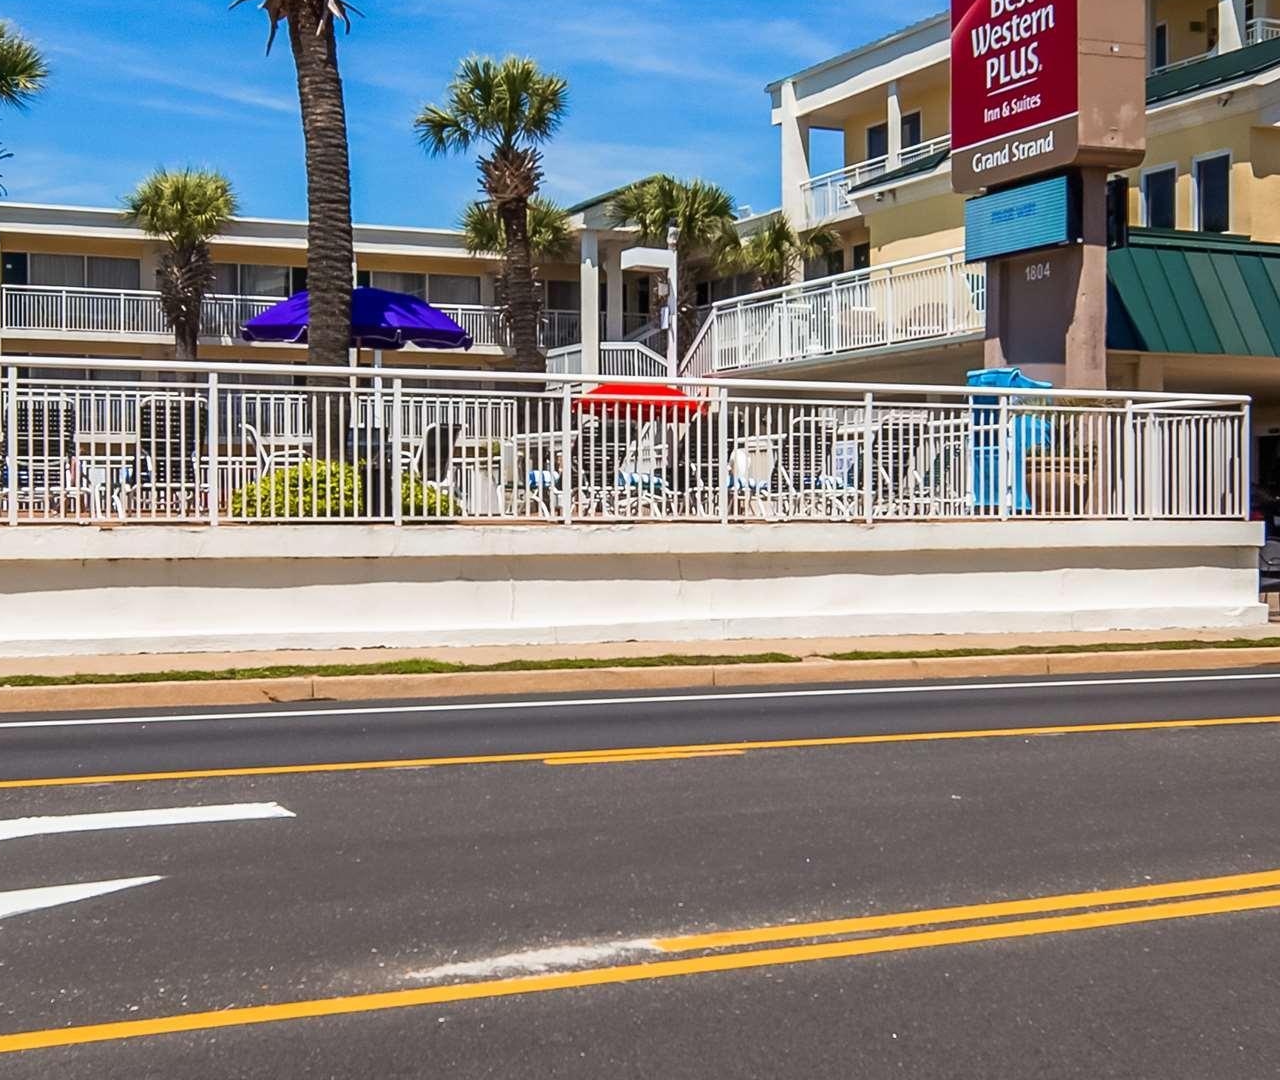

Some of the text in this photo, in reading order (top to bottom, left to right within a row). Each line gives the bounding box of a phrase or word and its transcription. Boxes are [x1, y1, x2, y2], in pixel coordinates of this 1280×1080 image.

[971, 4, 1055, 58] Western
[986, 41, 1040, 89] PLUS
[984, 93, 1042, 124] Inn & Suites
[972, 130, 1055, 173] Grand Strand
[1025, 261, 1051, 281] 1804
